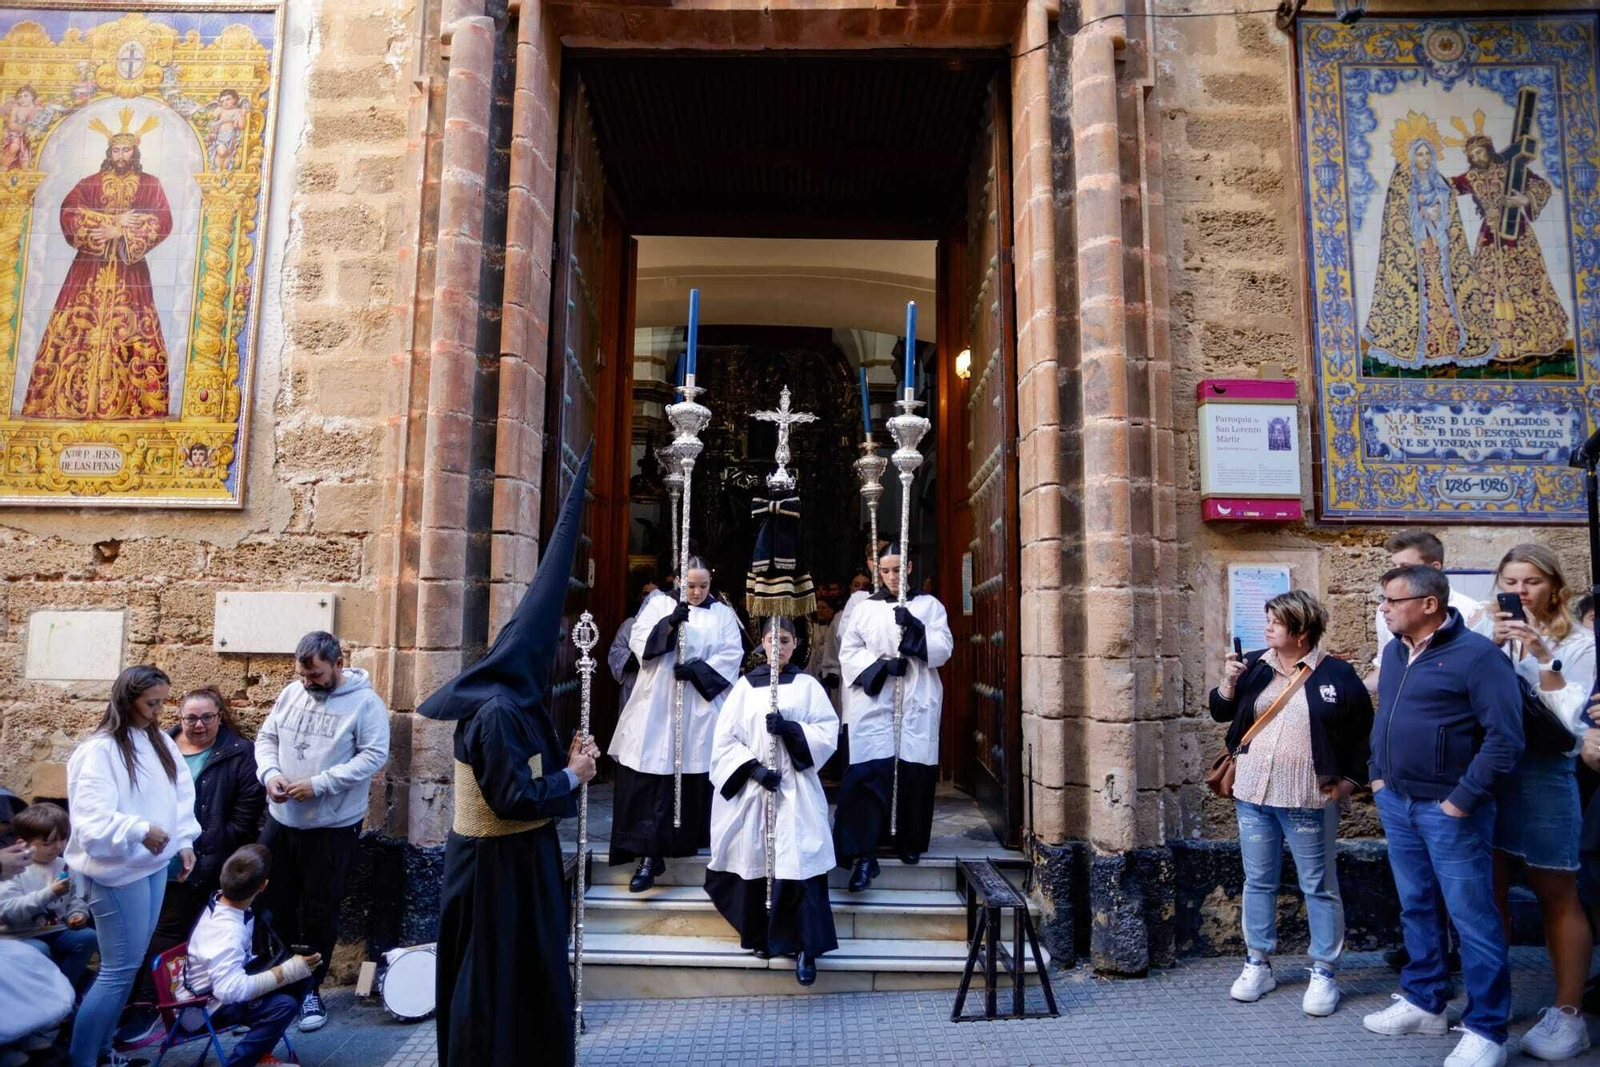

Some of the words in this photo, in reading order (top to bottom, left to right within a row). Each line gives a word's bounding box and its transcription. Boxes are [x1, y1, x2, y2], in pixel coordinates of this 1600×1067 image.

[1215, 416, 1252, 424] Parroquia
[1463, 417, 1485, 426] LOS
[1489, 416, 1550, 427] AFLIGIDOS
[1555, 418, 1564, 427] Y
[1450, 428, 1471, 437] LOS
[1475, 426, 1563, 439] DESCONSVELOS
[1216, 434, 1241, 443] Mártir
[1389, 436, 1414, 448] QVE
[1417, 439, 1430, 448] SE
[1433, 439, 1482, 449] VENERAN
[1484, 440, 1498, 448] EN
[1524, 439, 1560, 449] IGLESIA
[61, 462, 72, 471] DE
[74, 462, 91, 471] LAS
[93, 462, 121, 471] PENAS
[1445, 477, 1509, 494] 1726-1926
